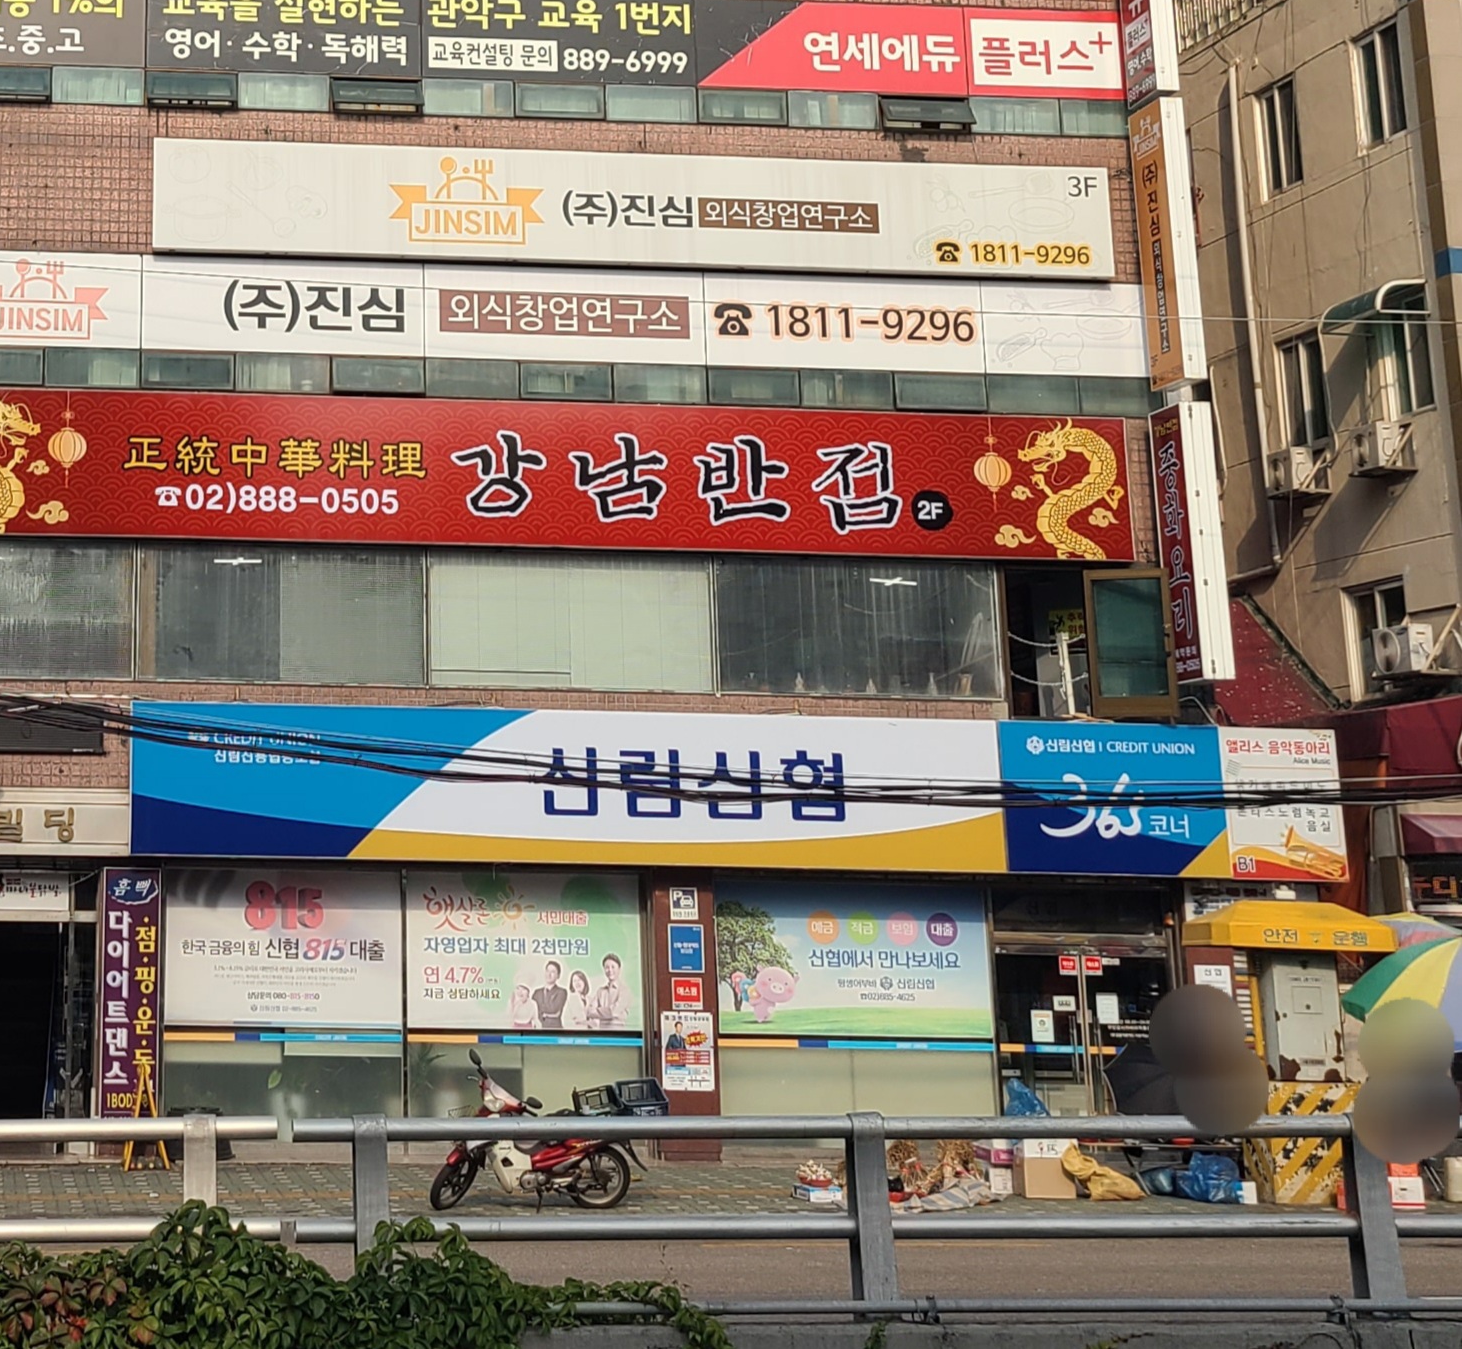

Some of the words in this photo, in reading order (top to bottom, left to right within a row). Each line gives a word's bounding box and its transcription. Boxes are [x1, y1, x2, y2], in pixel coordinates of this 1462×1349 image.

[616, 1, 692, 35] 1번지
[432, 40, 515, 68] 교육컨설팅
[520, 42, 554, 70] 문의
[563, 48, 688, 75] 889-6999
[802, 31, 961, 73] 연세에듀
[1067, 176, 1098, 198] 3F
[414, 204, 519, 238] JINSIM
[562, 189, 694, 228] (주)진심
[703, 201, 874, 230] 외식창업연구소
[969, 242, 1091, 266] 1811-9296
[223, 279, 406, 334] (주)진심
[447, 294, 681, 334] 외식창업연구소
[765, 303, 975, 344] 1811-9296
[123, 436, 427, 479] 正統中華料理
[453, 429, 902, 535] 강남반점
[917, 501, 943, 521] 2F
[185, 483, 399, 515] 02)888-0505
[1158, 440, 1192, 641] 중화요리
[1046, 740, 1096, 753] 신림신협
[1106, 741, 1149, 754] CREDIT
[1152, 742, 1195, 755] UNION
[1225, 739, 1264, 754] 앨리스
[1268, 740, 1331, 755] 음악동아리
[541, 746, 847, 822] 신림신협
[1148, 815, 1190, 839] 코너
[1237, 856, 1256, 872] B1
[244, 880, 324, 931] 815
[422, 885, 490, 932] 햇살론
[537, 910, 588, 926] 서민대출
[810, 920, 834, 935] 예금
[851, 920, 874, 936] 적금
[890, 921, 915, 936] 보험
[930, 922, 954, 938] 대출
[423, 936, 489, 955] 자영업자
[494, 937, 527, 955] 최대
[532, 938, 589, 956] 2천만원
[1263, 928, 1298, 944] 안전
[181, 939, 207, 956] 한국
[209, 940, 246, 956] 금융의
[248, 940, 260, 956] 힘
[265, 937, 300, 960] 신협
[303, 938, 347, 961] 815
[350, 939, 385, 961] 대출
[808, 949, 874, 969] 신협에서
[878, 950, 962, 970] 만나보세요
[423, 965, 440, 985] 연
[444, 966, 484, 984] 4.7%
[896, 978, 936, 990] 신림신협
[103, 910, 133, 1085] 다이어트댄스
[423, 988, 444, 1000] 지금
[447, 988, 501, 1000] 상담하세요
